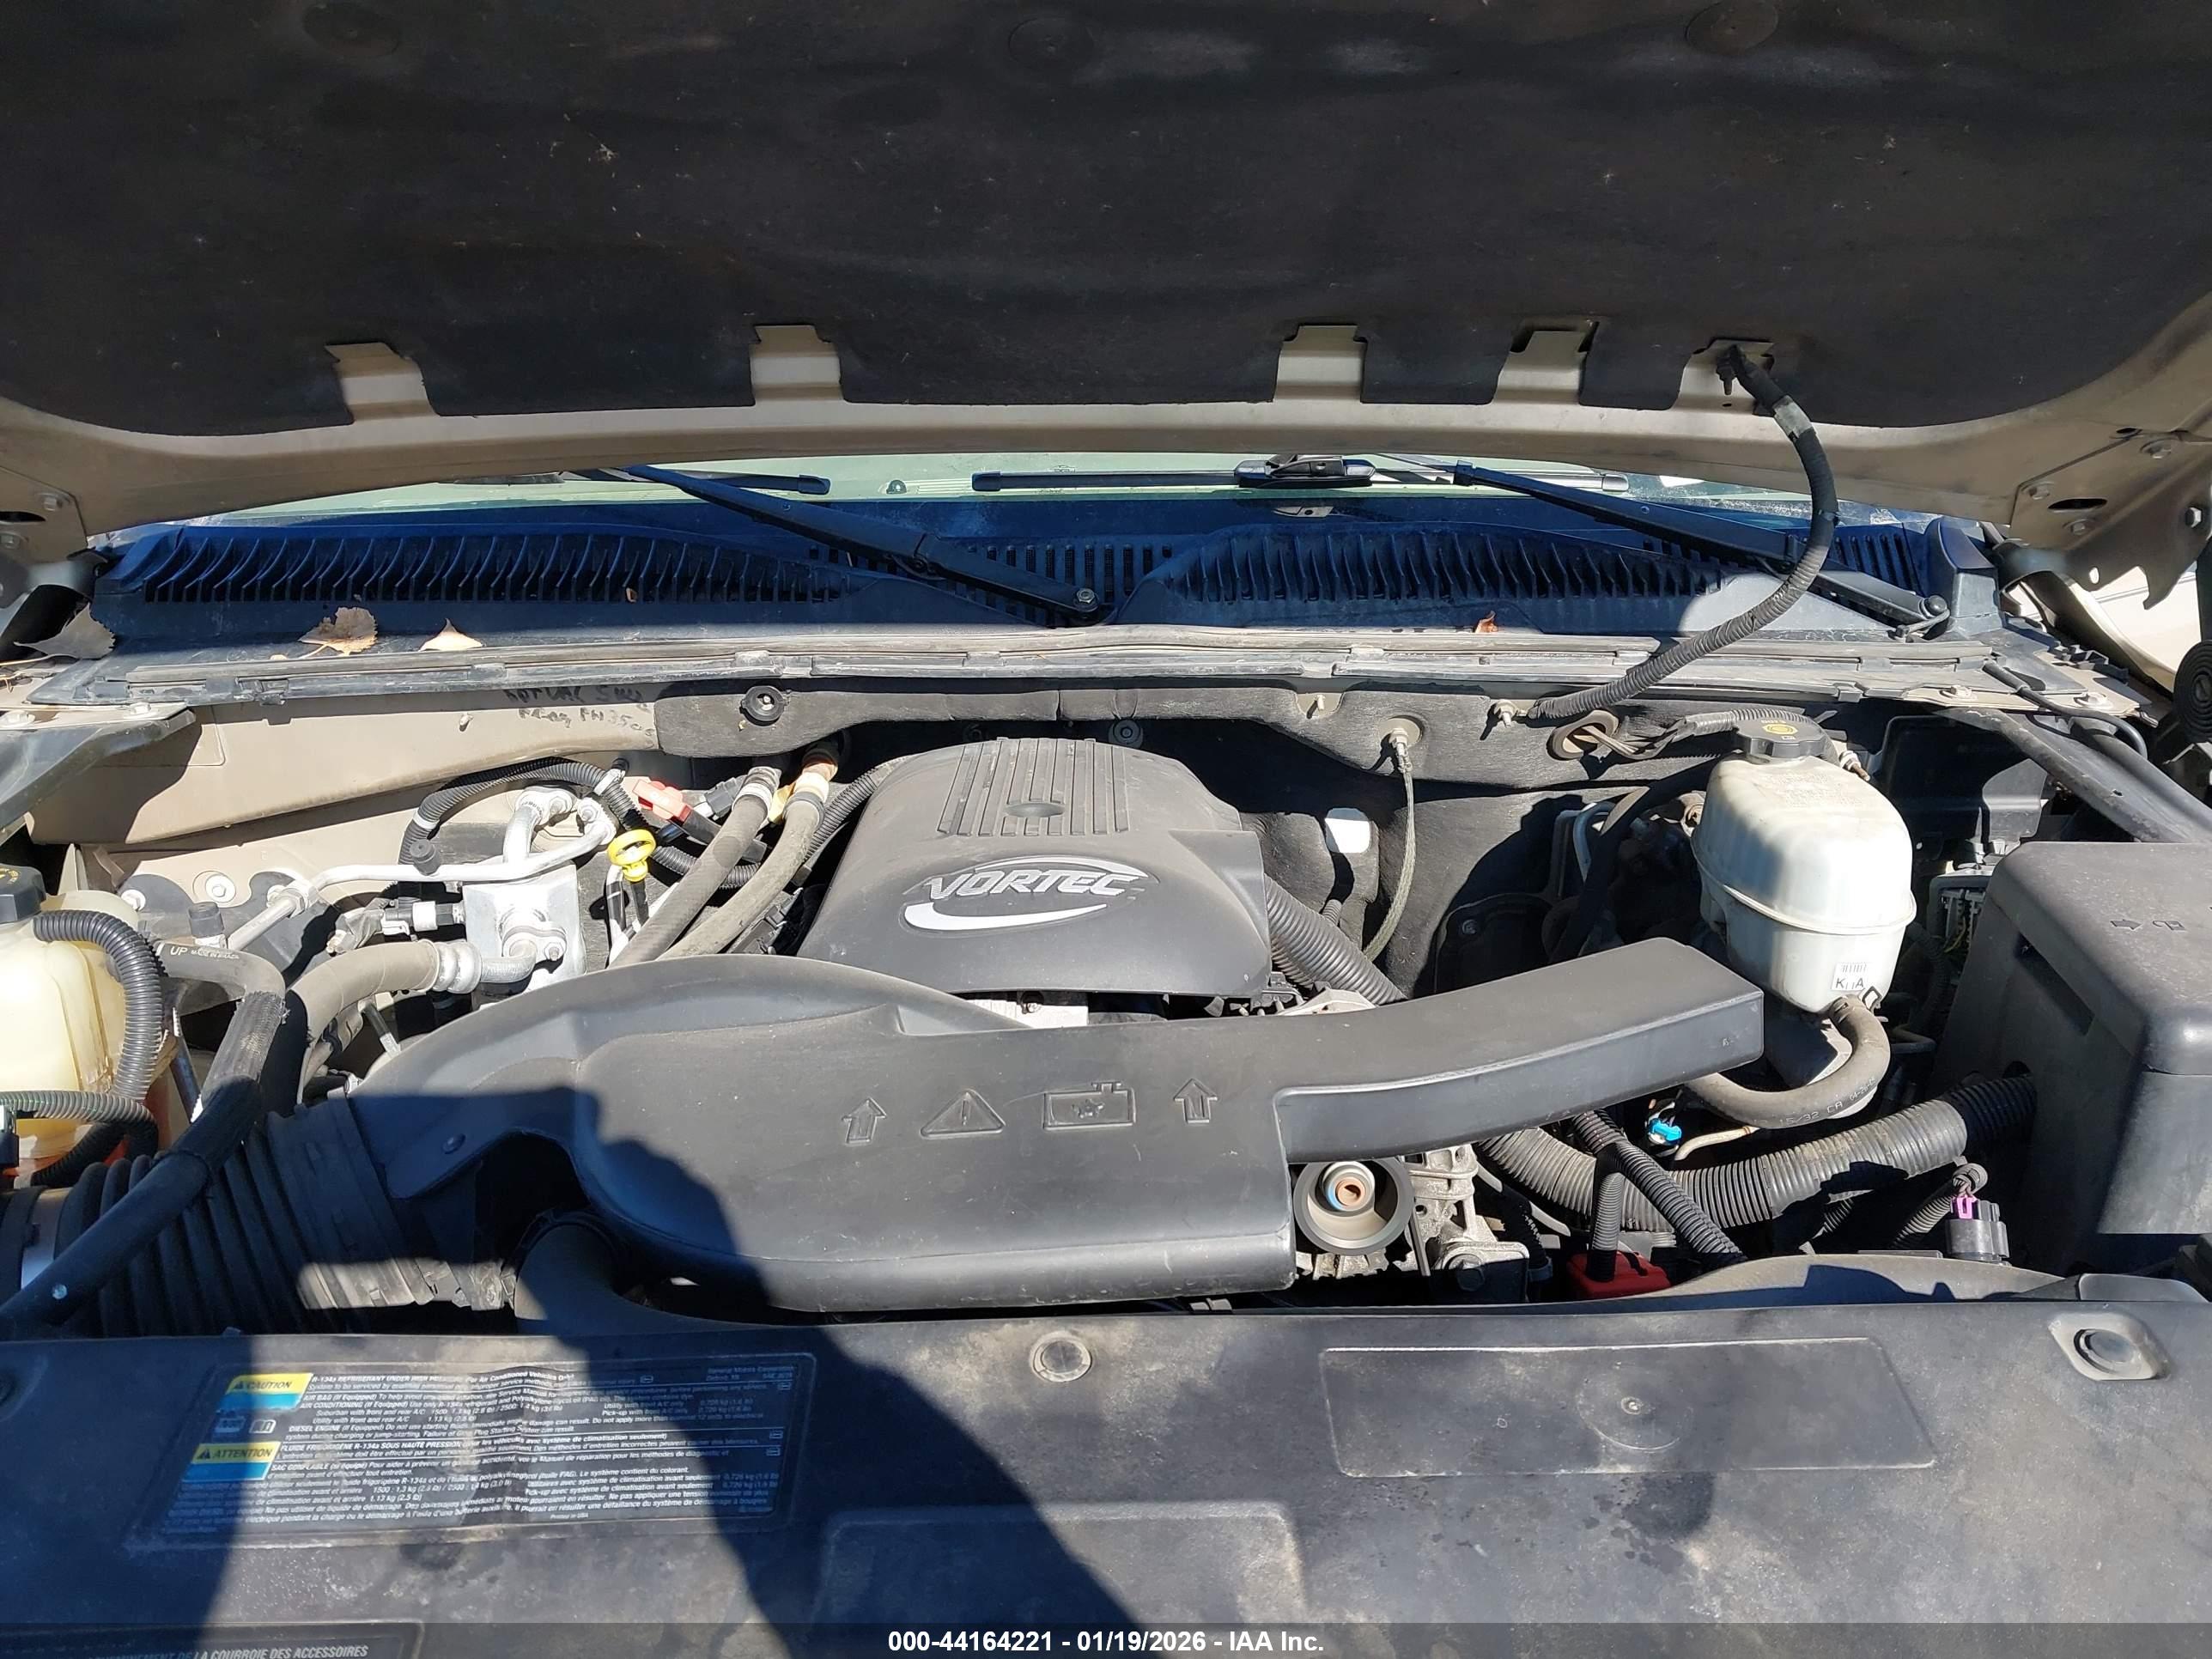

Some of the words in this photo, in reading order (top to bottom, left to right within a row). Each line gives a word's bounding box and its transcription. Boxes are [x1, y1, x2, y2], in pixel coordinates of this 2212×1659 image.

[923, 869, 1139, 900] VORTEC
[170, 946, 188, 956] UP
[1826, 1101, 1843, 1114] CA
[490, 1371, 528, 1382] Conditioned
[246, 1380, 292, 1389] CAUTION
[373, 1401, 408, 1410] Equipped)
[498, 1396, 510, 1405] and
[602, 1409, 629, 1418] Pick-up
[614, 1417, 633, 1425] apply
[542, 1437, 571, 1445] système
[629, 1434, 667, 1442] seulement)
[658, 1440, 687, 1449] peuvent
[213, 1448, 272, 1457] ATTENTION
[576, 1454, 612, 1463] réparation
[362, 1478, 400, 1486] frigorigène
[590, 1470, 619, 1478] système
[577, 1478, 608, 1487] système
[569, 1487, 598, 1495] système
[633, 1492, 667, 1501] appliquer
[652, 1500, 681, 1509] système
[193, 1650, 208, 1659] LA
[210, 1648, 268, 1659] COURROIE
[269, 1647, 292, 1659] DES
[293, 1644, 369, 1658] ACCESSOIRES
